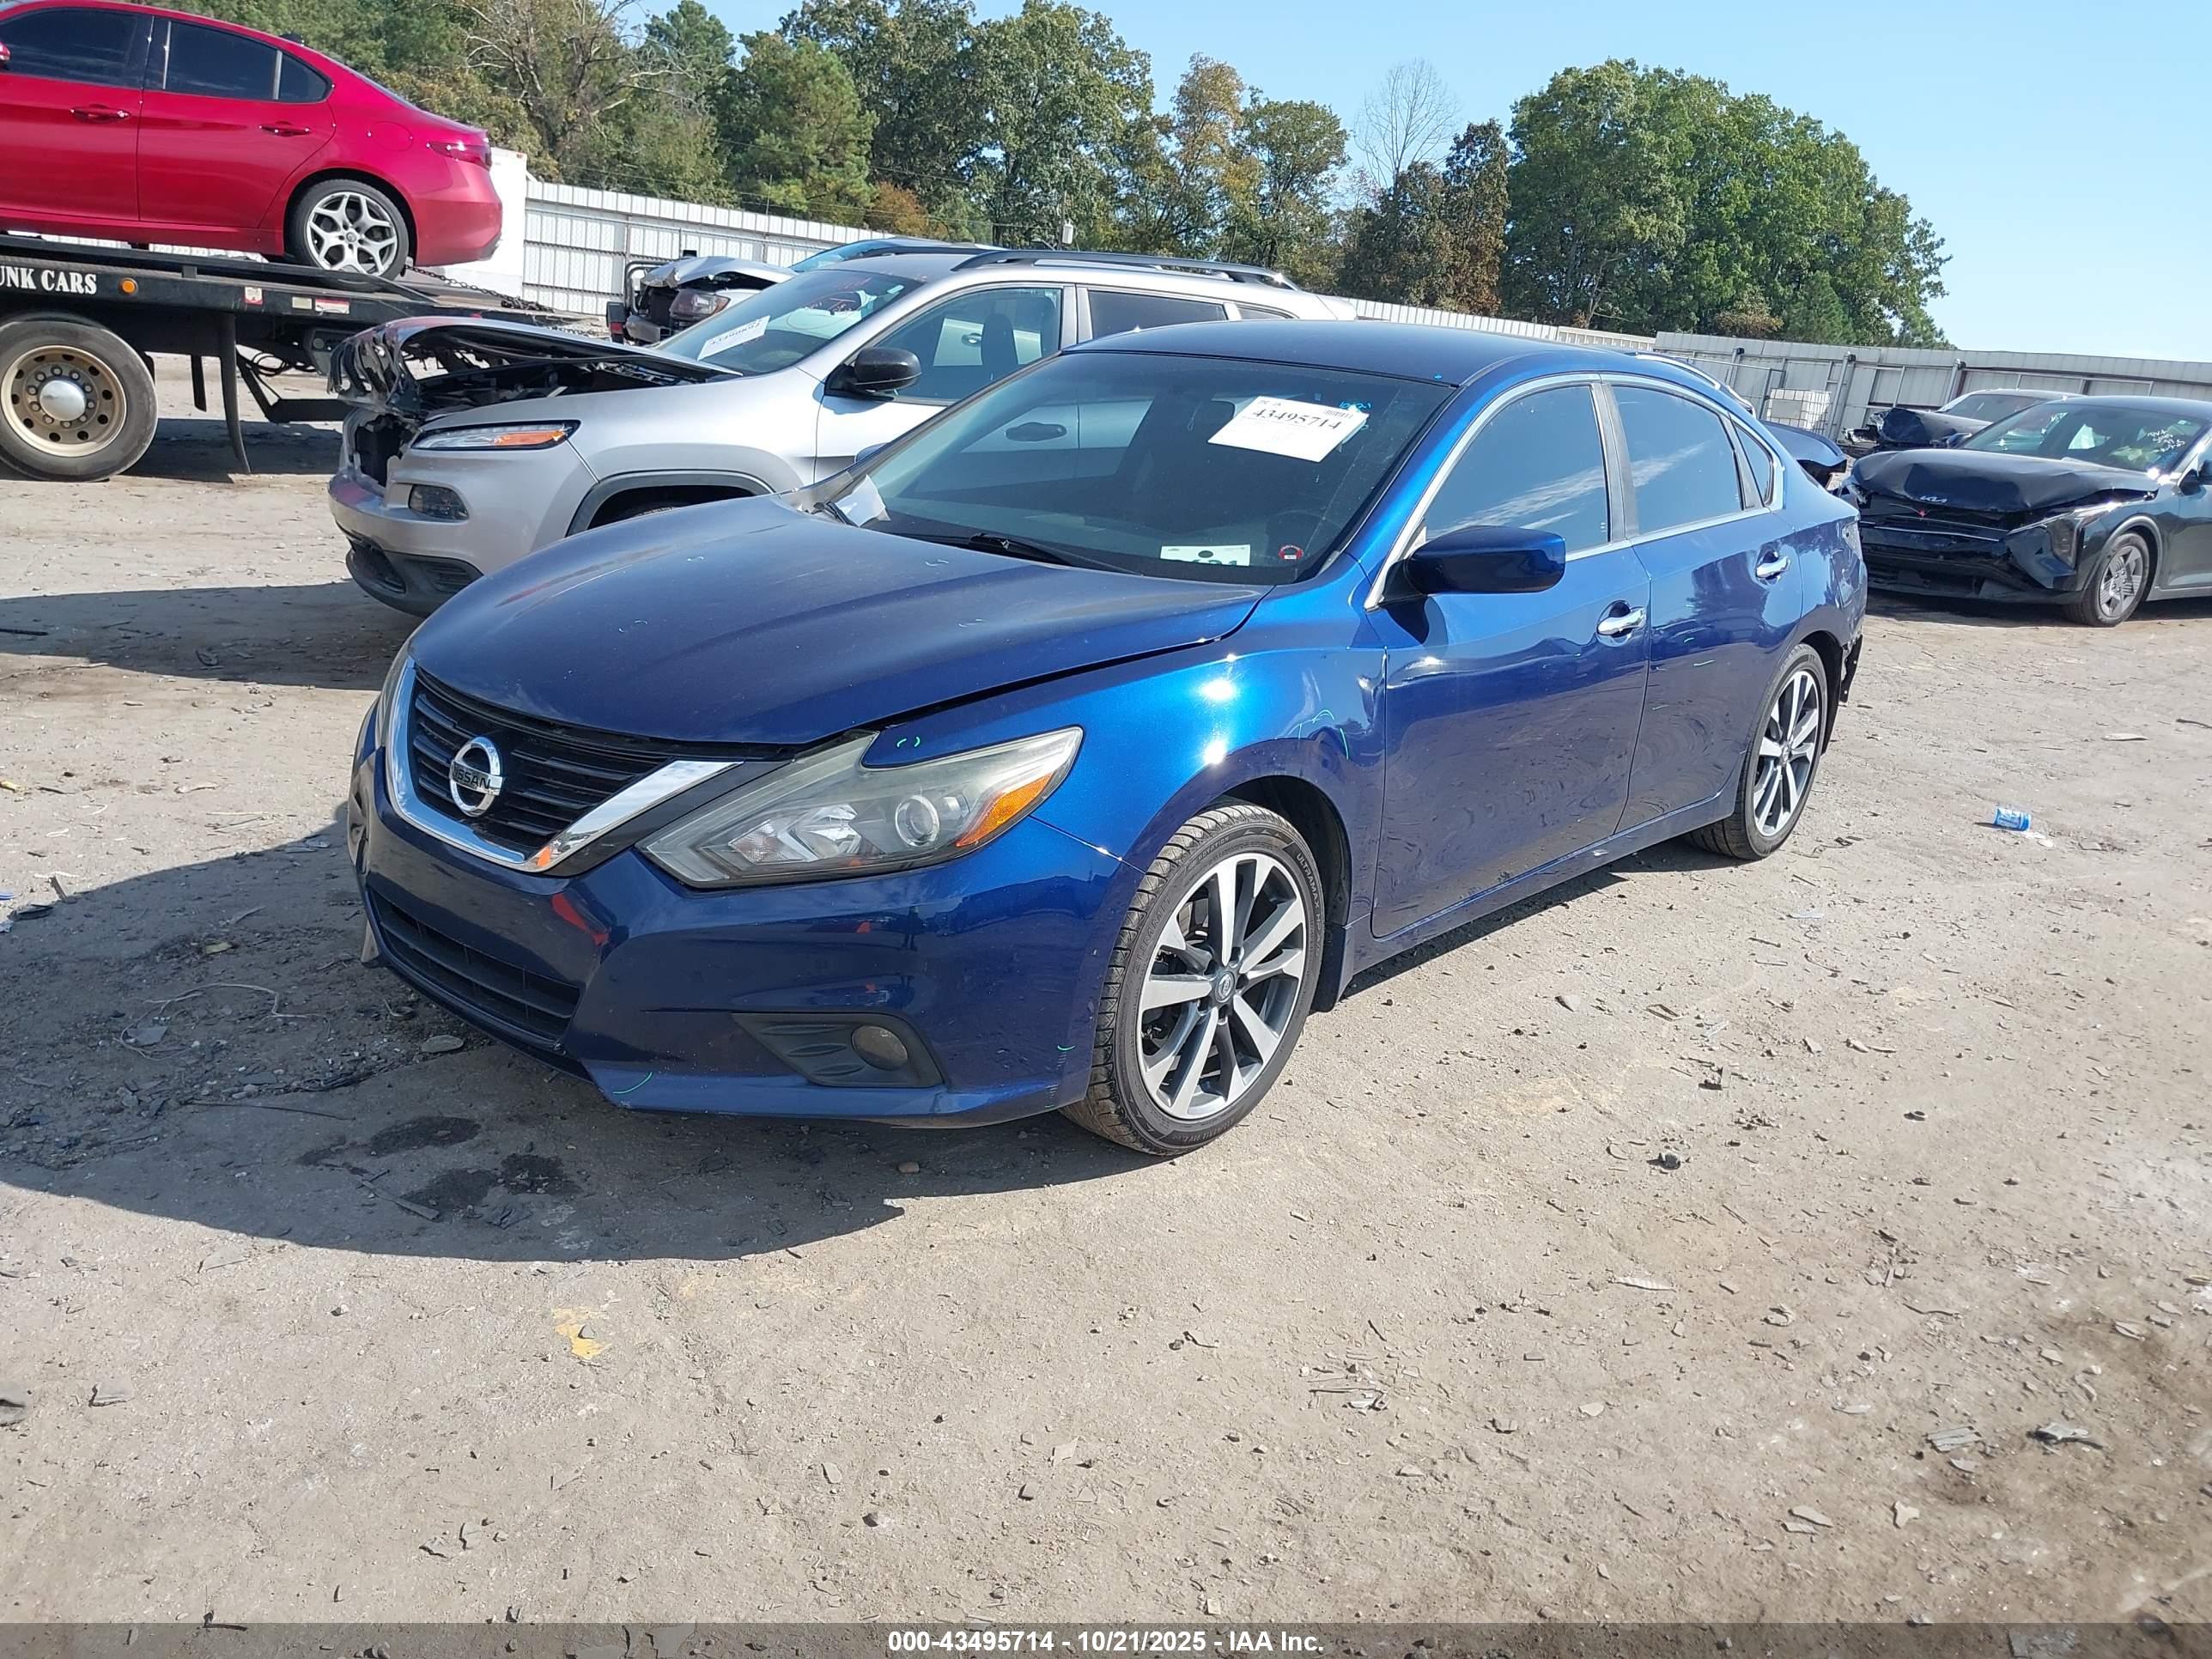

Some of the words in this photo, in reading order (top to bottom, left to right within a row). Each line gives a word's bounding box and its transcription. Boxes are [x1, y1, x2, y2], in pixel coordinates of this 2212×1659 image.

[40, 269, 97, 295] CARS
[1253, 409, 1342, 430] 43495714
[451, 766, 491, 789] NISSAN
[1295, 854, 1321, 907] ULTRAMAX
[1316, 913, 1323, 933] HP
